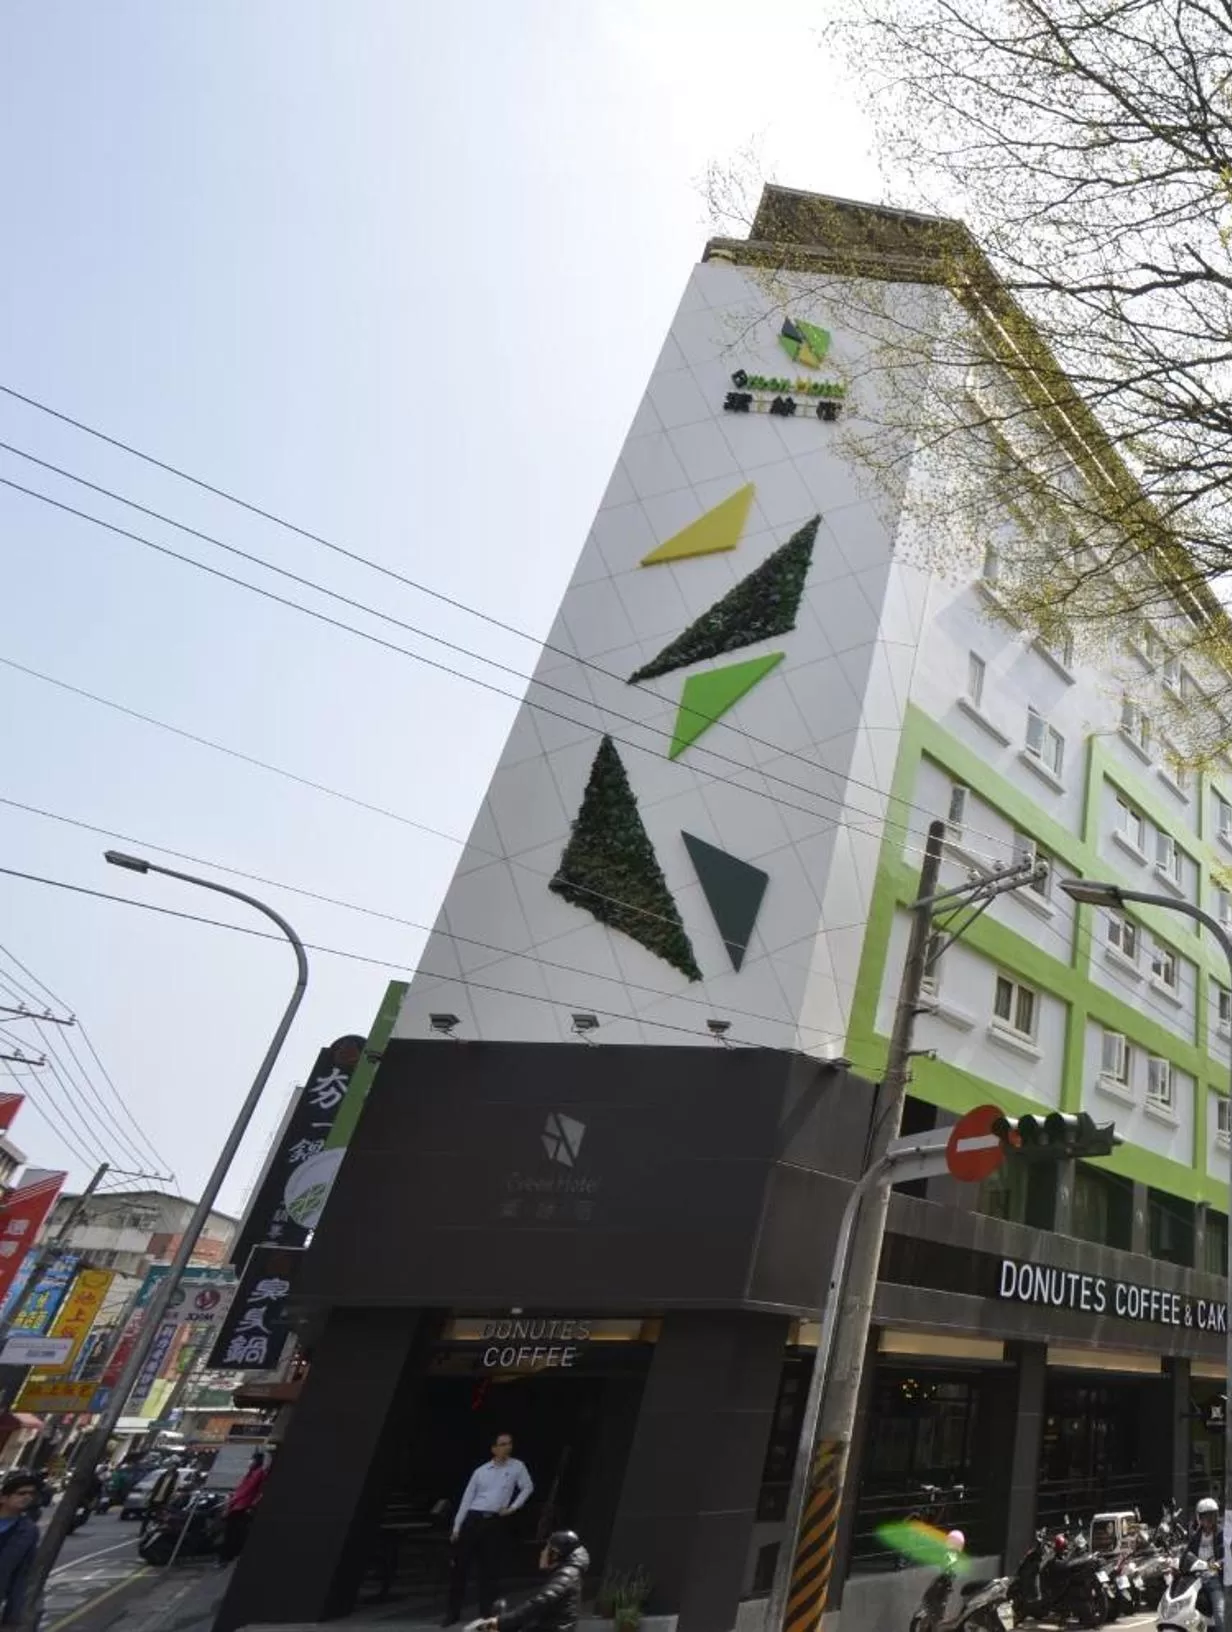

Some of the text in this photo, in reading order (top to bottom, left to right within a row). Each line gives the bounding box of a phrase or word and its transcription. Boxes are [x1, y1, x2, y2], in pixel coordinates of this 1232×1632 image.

[999, 1260, 1228, 1332] DONUTES COFFEE & CAK
[480, 1320, 592, 1340] DONUTES
[483, 1347, 577, 1367] COFFEE
